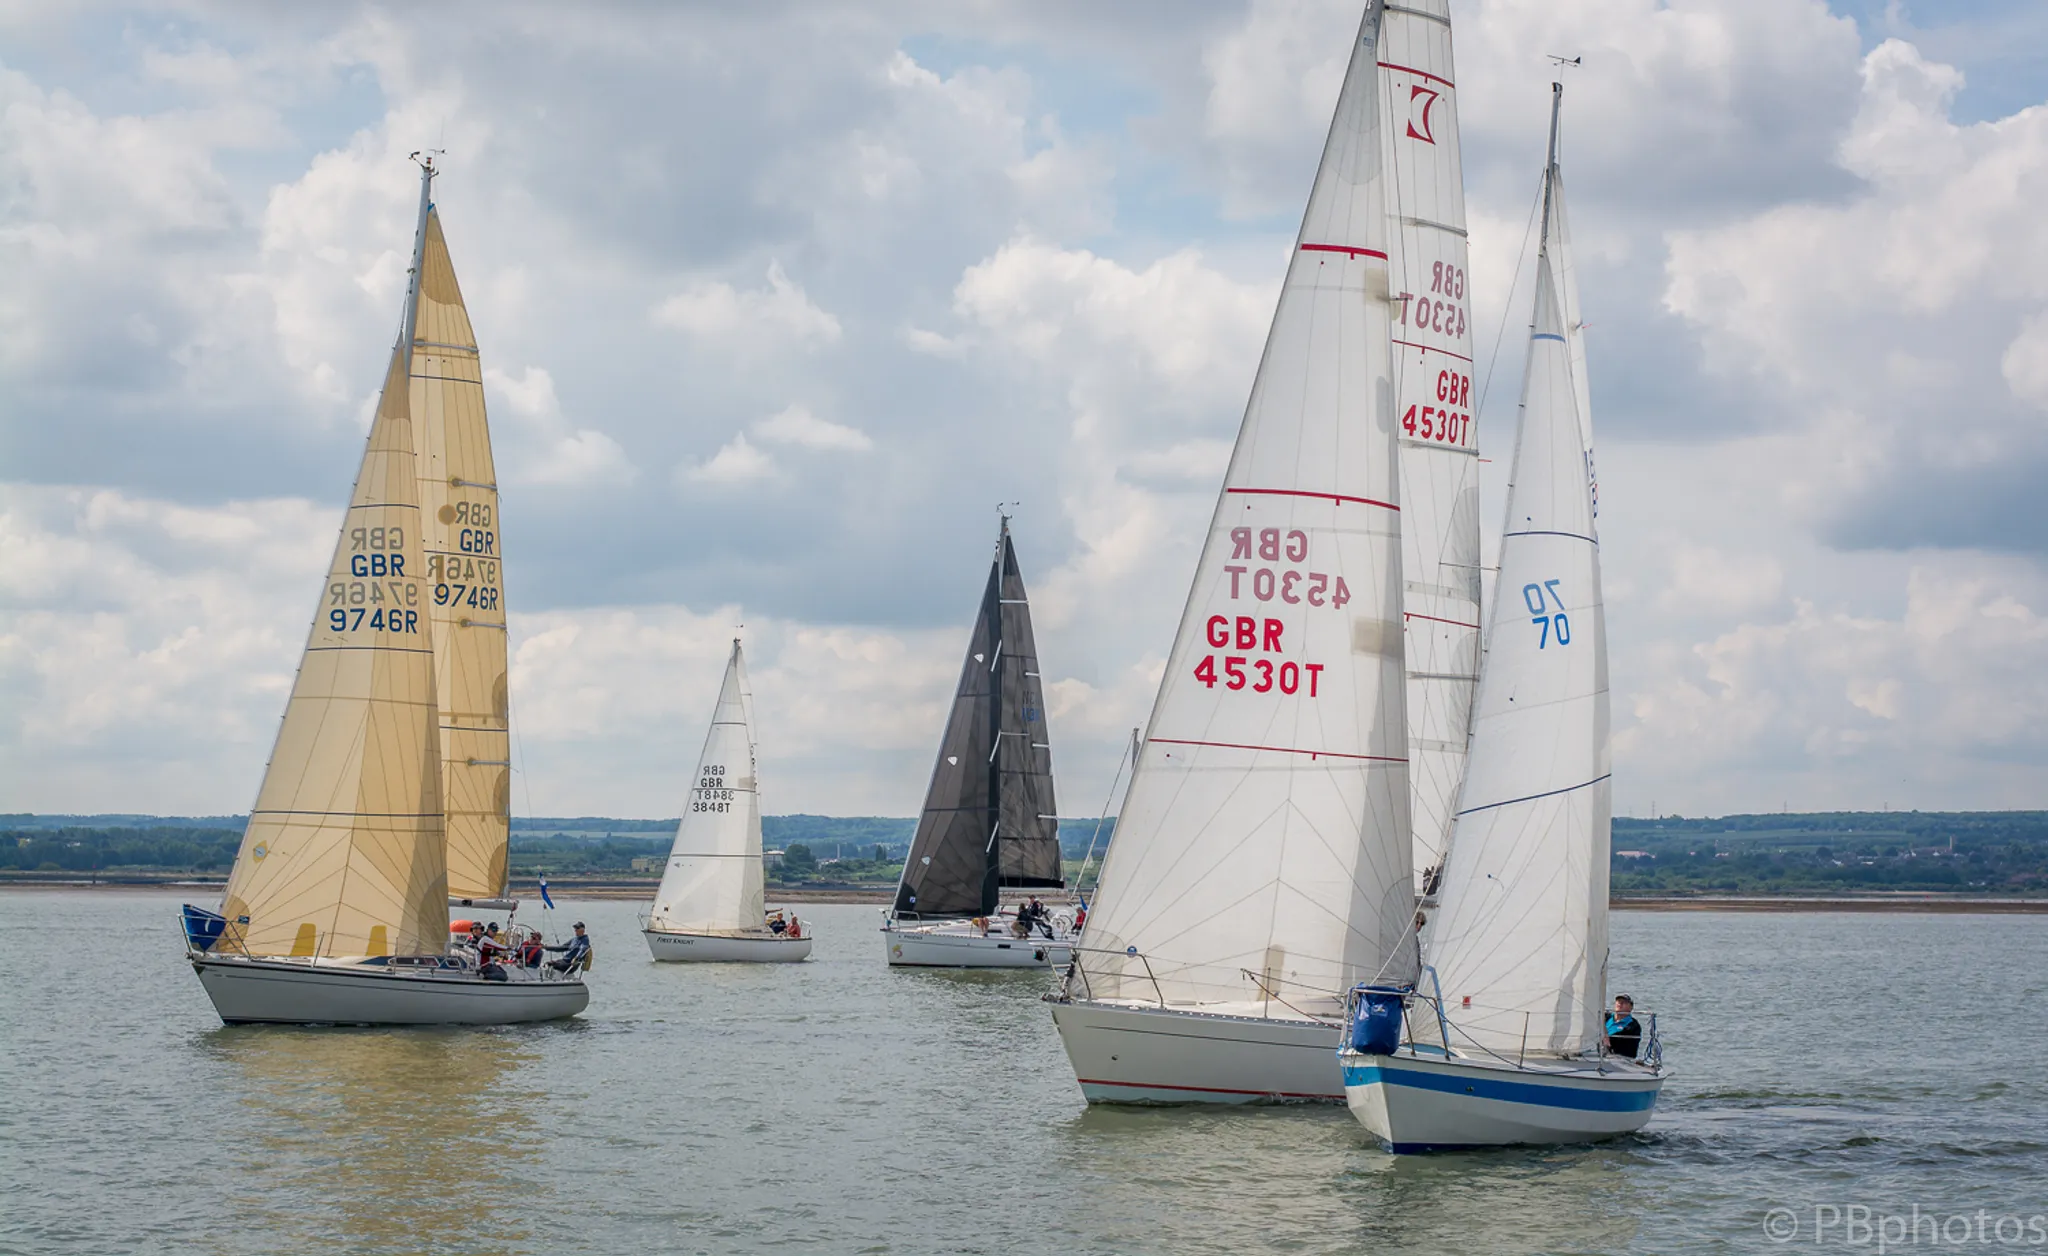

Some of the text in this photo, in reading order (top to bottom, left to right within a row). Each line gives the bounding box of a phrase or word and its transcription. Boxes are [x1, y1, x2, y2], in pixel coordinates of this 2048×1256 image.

[1437, 369, 1469, 409] GBR
[1402, 404, 1470, 447] 4530T
[460, 528, 494, 555] GBR
[351, 553, 405, 578] GBR
[434, 583, 498, 611] 9746R
[330, 608, 418, 634] 9746R
[1206, 614, 1284, 654] GBR
[1532, 613, 1570, 649] 70
[1193, 655, 1324, 698] 4530T
[700, 777, 723, 788] GBR
[692, 802, 731, 814] 3848T
